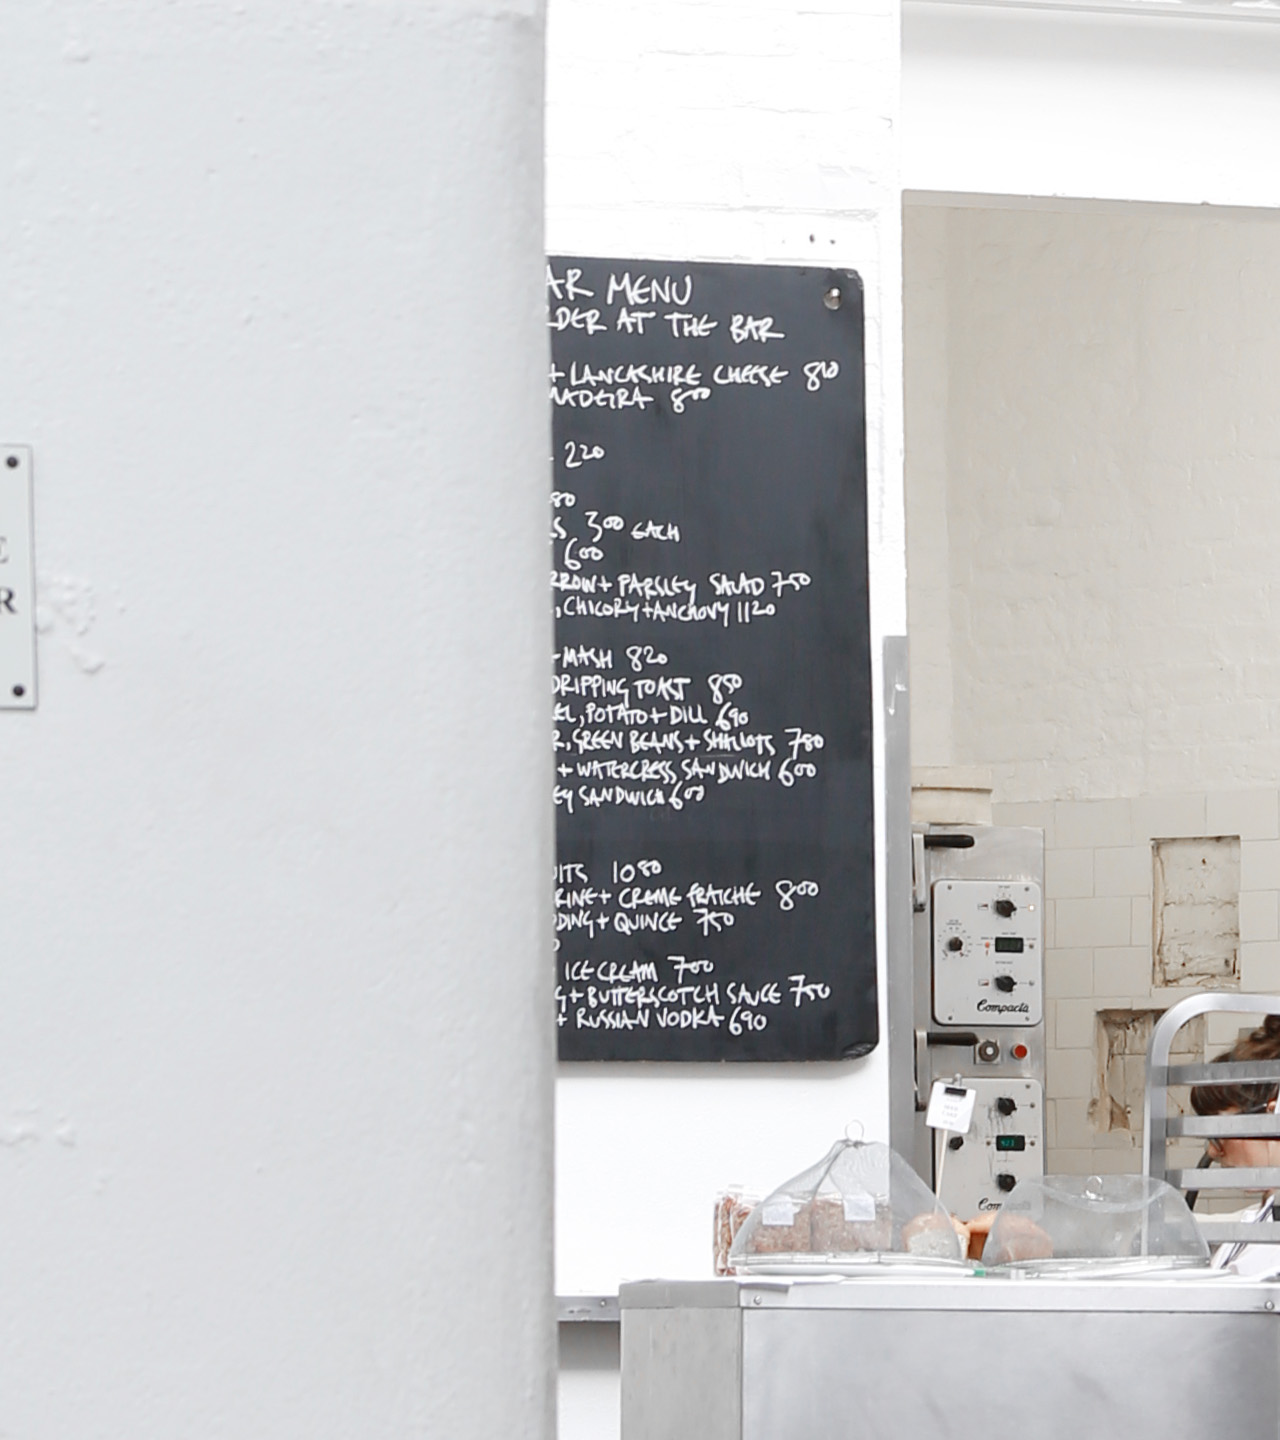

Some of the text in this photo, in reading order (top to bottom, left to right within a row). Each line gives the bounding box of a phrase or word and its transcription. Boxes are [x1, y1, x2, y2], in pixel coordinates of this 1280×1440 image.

[606, 272, 693, 306] MENU
[617, 306, 656, 334] AT
[664, 311, 718, 338] THE
[730, 314, 785, 343] BAR
[569, 361, 702, 387] LANCASHIRE
[713, 364, 789, 387] CHEESE
[630, 520, 681, 542] EACH
[618, 573, 696, 604] PARSLEY
[709, 572, 766, 597] SALAD
[561, 644, 613, 669] MASH
[633, 676, 692, 701] TOAST
[669, 704, 709, 726] DILL
[629, 729, 684, 754] BEANS
[681, 758, 771, 784] SANDWICH
[578, 785, 666, 808] SANDWICH
[618, 886, 682, 910] CREME
[552, 911, 594, 939] DING
[613, 911, 683, 936] QUINCE
[587, 983, 720, 1008] BUTTERSCOTCH
[726, 983, 782, 1007] SAUCE
[576, 1007, 649, 1030] RUSSIAN
[656, 1005, 724, 1029] VODKA
